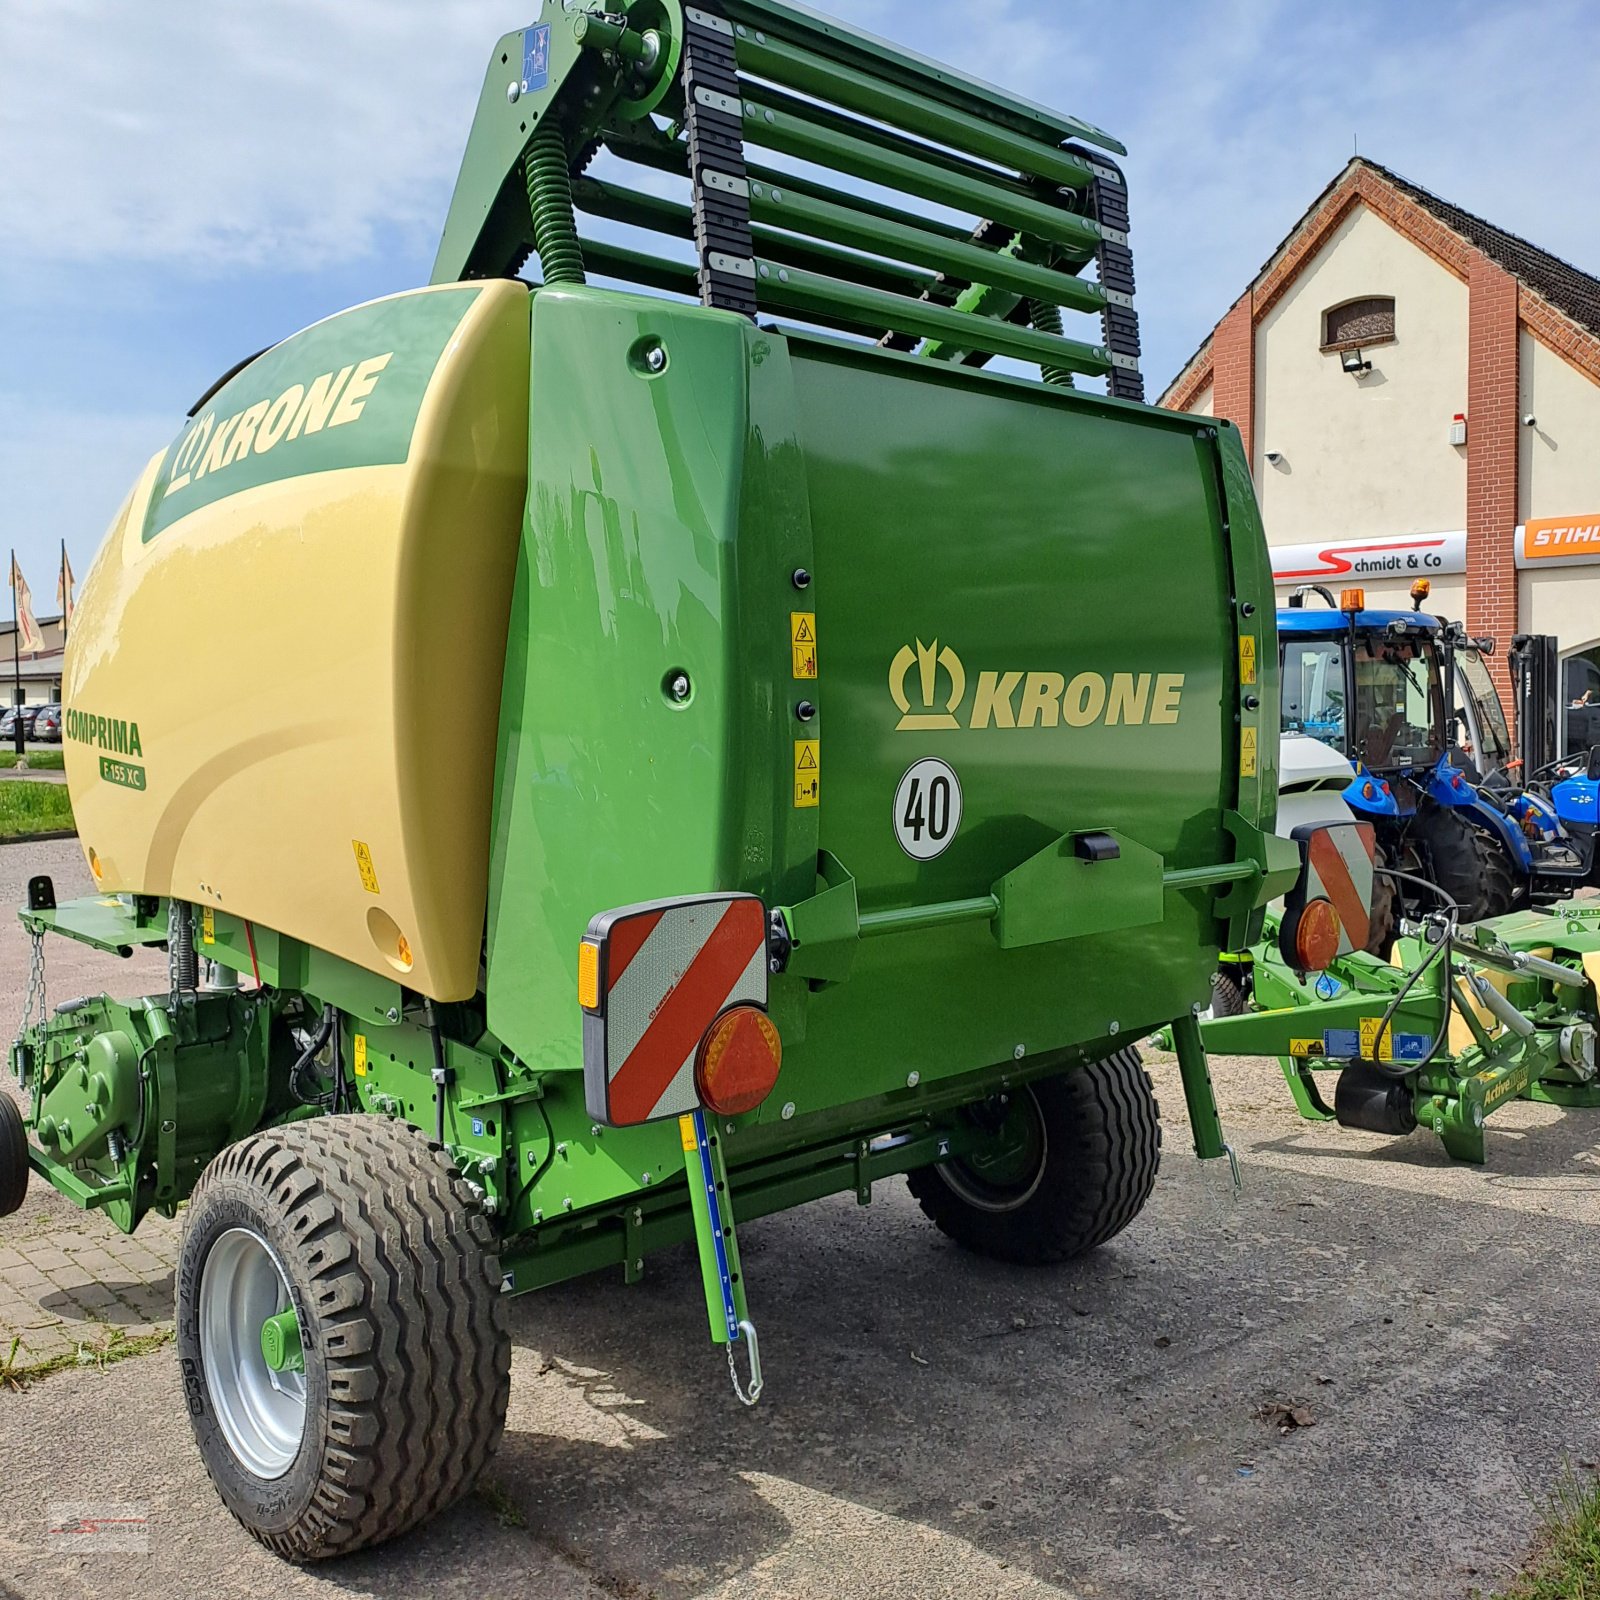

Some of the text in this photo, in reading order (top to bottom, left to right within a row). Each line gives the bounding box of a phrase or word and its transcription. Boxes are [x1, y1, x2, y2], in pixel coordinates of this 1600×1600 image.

[194, 351, 394, 481] KRONE
[1533, 521, 1600, 546] STIHL
[1317, 547, 1442, 574] Schmidt & Co
[969, 670, 1186, 729] KRONE
[66, 707, 143, 758] COMPRIMA
[103, 761, 141, 786] F 155 XC
[903, 775, 950, 842] 40
[701, 1139, 707, 1147] 4
[708, 1185, 714, 1193] 5
[715, 1229, 721, 1237] 6
[722, 1276, 728, 1284] 7
[181, 1357, 204, 1416] BKT
